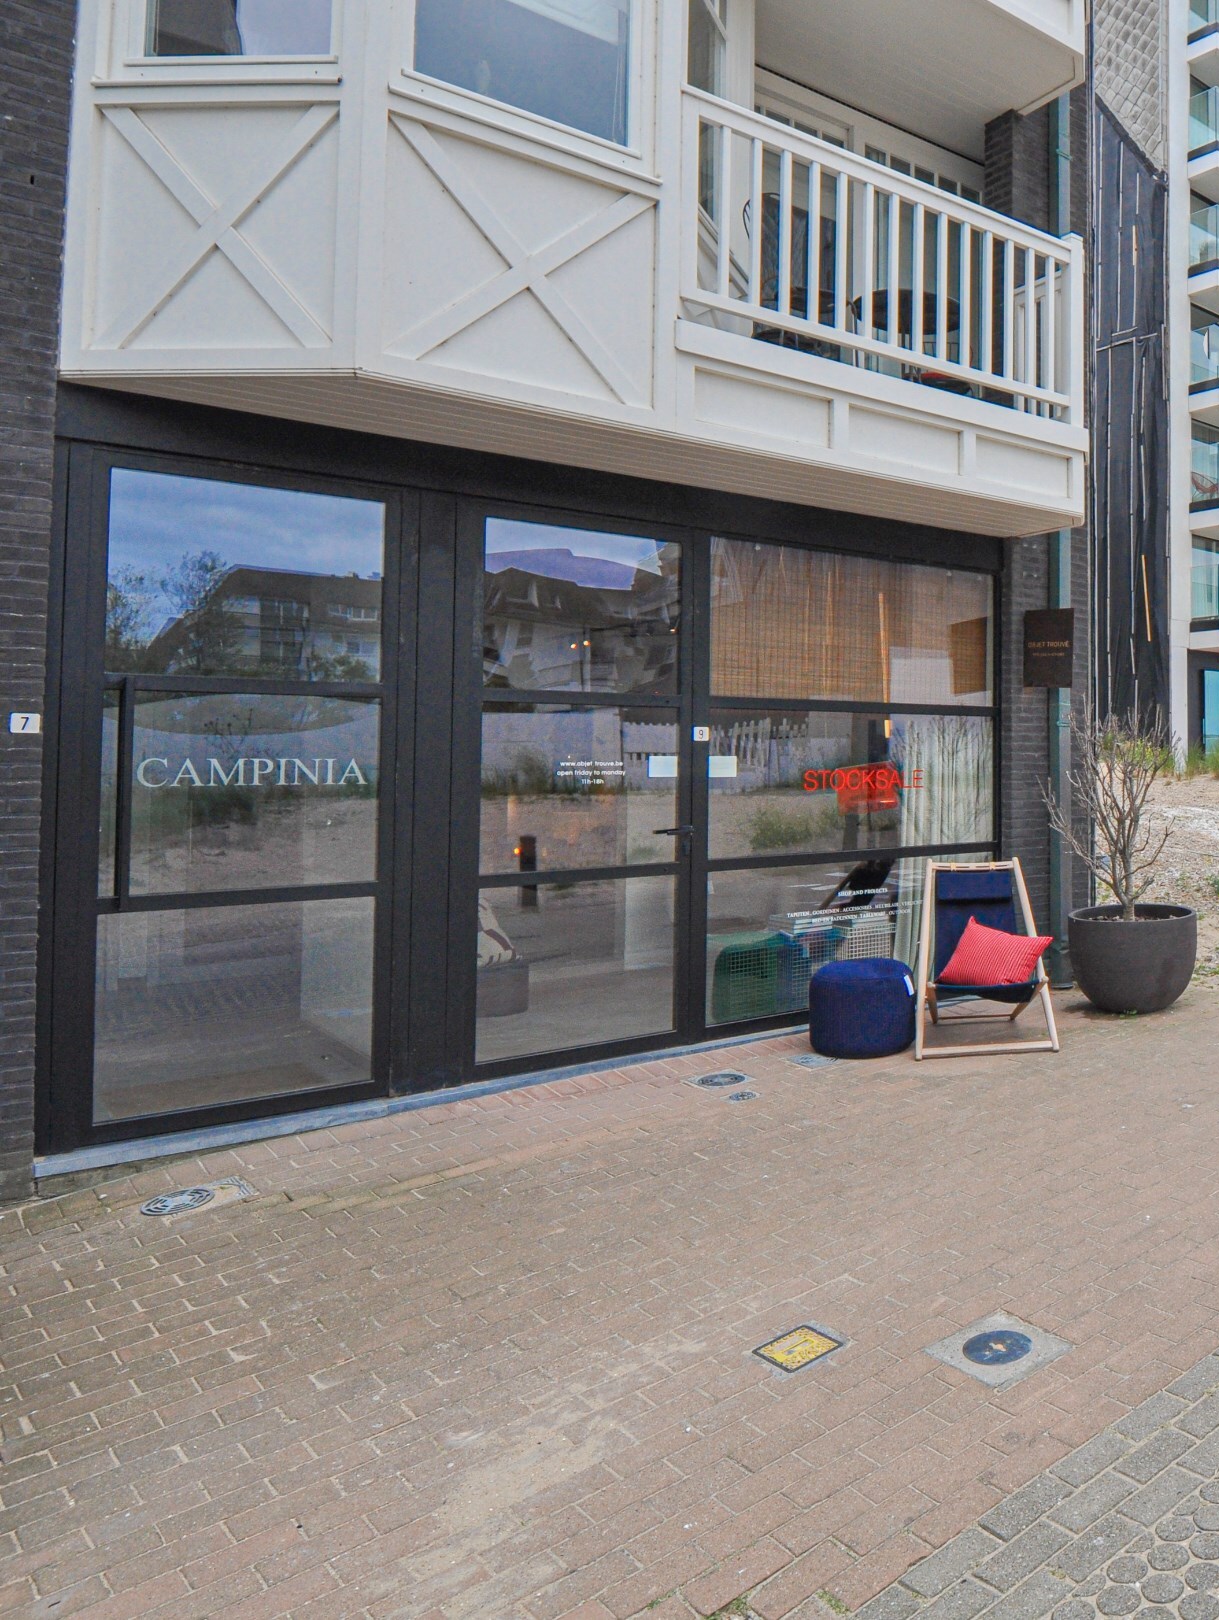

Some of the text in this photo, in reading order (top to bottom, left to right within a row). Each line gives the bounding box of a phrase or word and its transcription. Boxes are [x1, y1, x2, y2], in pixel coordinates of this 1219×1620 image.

[20, 716, 30, 731] 7
[698, 729, 704, 740] 9
[136, 757, 368, 788] CAMPINIA
[803, 769, 923, 791] STOCKSALE
